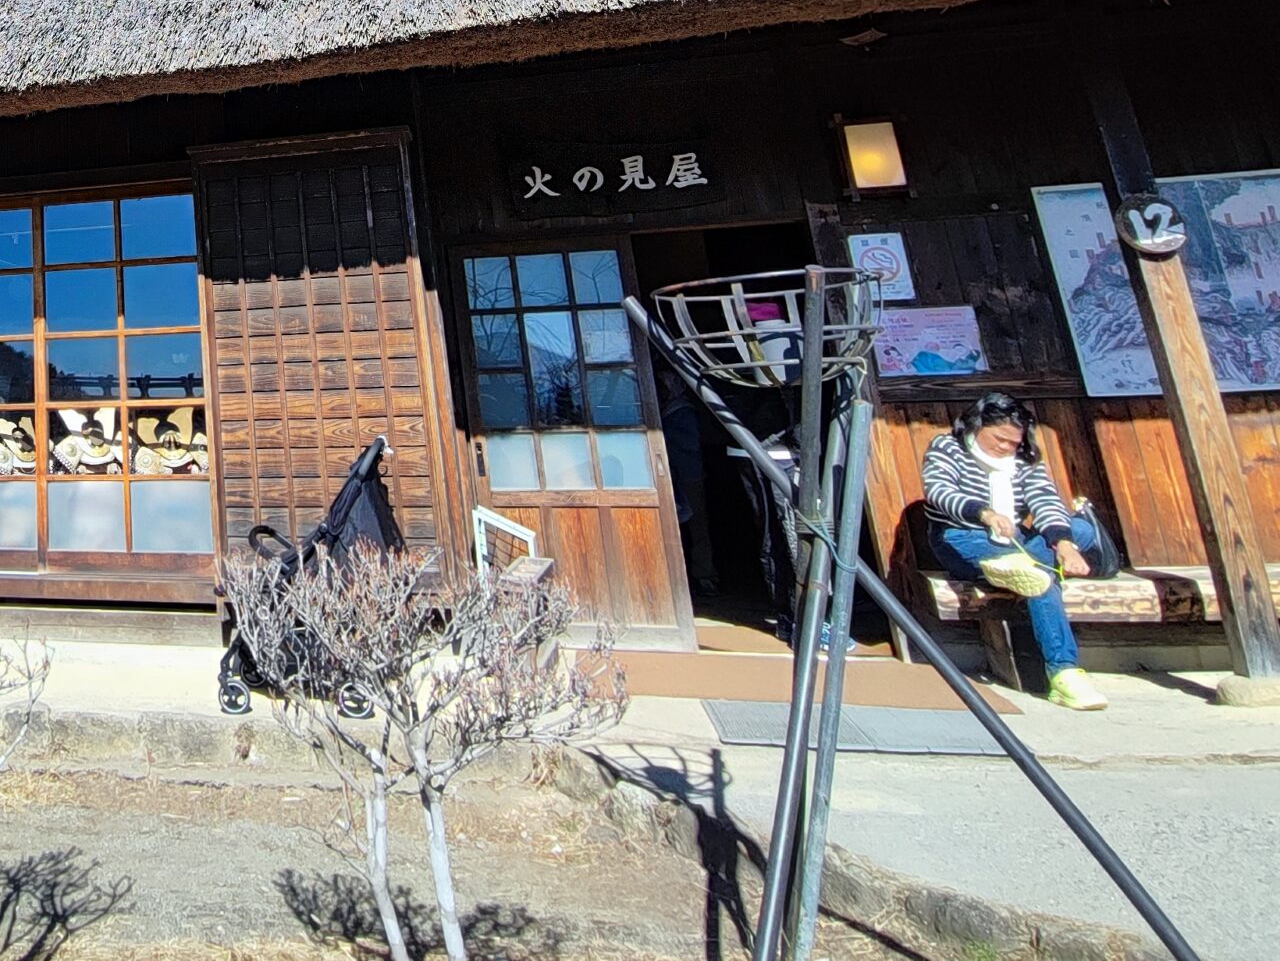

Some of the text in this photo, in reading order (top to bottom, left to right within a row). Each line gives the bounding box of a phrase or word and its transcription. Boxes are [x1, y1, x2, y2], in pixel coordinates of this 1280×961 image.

[523, 152, 708, 199] 火の見屋
[1128, 203, 1186, 245] 12
